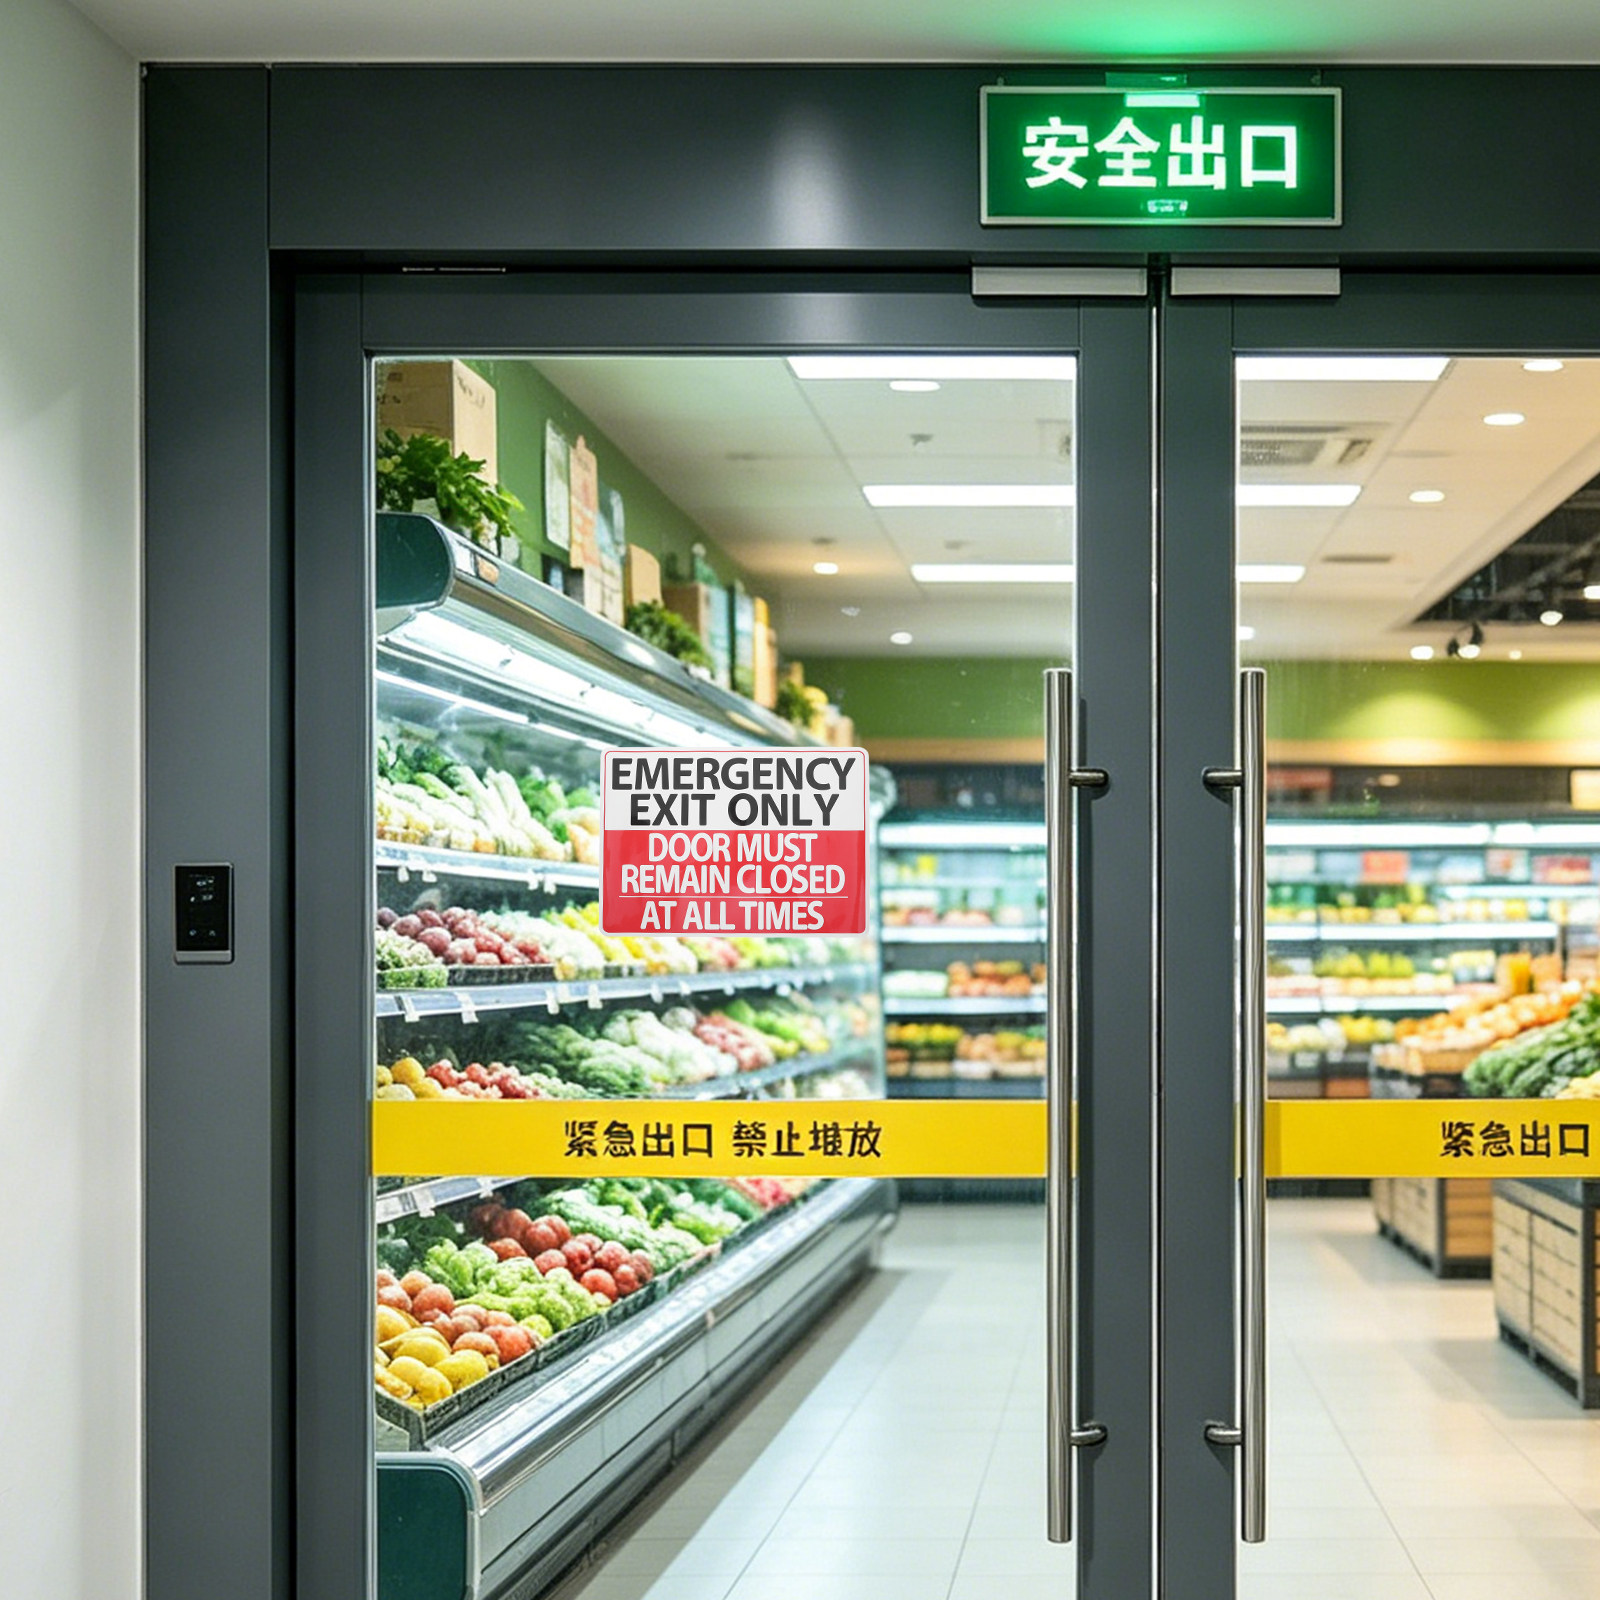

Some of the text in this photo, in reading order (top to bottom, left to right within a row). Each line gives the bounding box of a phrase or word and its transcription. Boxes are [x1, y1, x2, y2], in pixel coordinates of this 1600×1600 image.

[1022, 115, 1298, 189] 安全出口
[611, 757, 856, 791] EMERGENCY
[630, 792, 840, 826] EXIT ONLY
[648, 832, 818, 862] DOOR MUST
[621, 864, 846, 894] REMAIN CLOSED
[640, 900, 825, 930] AT ALL TIMES
[564, 1120, 713, 1158] 紧急出口
[1440, 1120, 1590, 1158] 紧急出口
